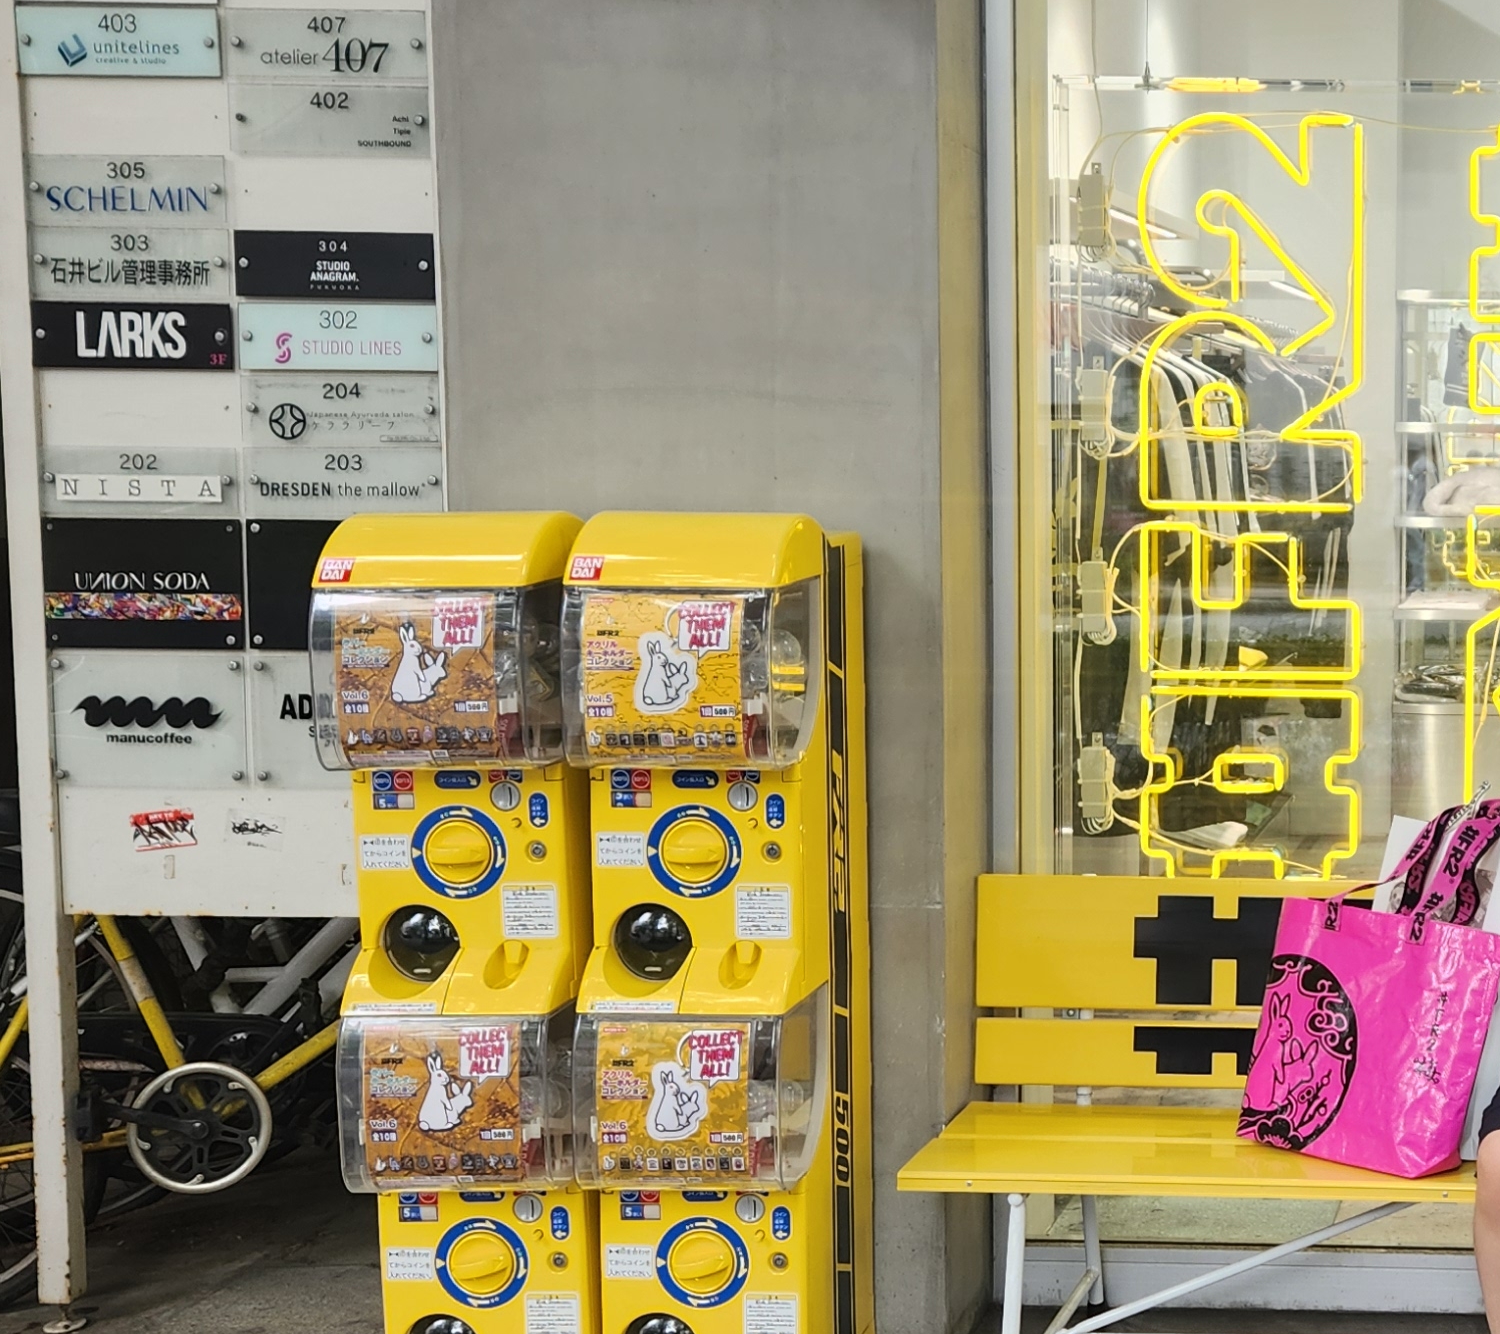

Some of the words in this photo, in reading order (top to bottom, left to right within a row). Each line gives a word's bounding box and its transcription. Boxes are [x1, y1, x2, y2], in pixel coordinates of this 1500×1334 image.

[98, 14, 137, 33] 403
[307, 16, 346, 34] 407
[94, 40, 180, 55] unitelines
[260, 48, 319, 65] atelier
[322, 37, 389, 73] 407
[310, 92, 349, 109] 402
[107, 162, 145, 179] 305
[46, 185, 208, 212] SCHELMIN
[110, 234, 149, 251] 303
[318, 241, 348, 252] 304
[50, 257, 210, 286] 石井ビル管理事務所
[316, 260, 350, 271] STUDIO
[310, 272, 360, 282] ANAGRAM.
[319, 310, 357, 329] 302
[76, 310, 187, 359] LARKS
[302, 340, 354, 355] STUDIO
[360, 340, 402, 355] LINES
[210, 354, 228, 365] 3F
[322, 382, 361, 399] 204
[119, 453, 158, 470] 202
[324, 454, 362, 471] 203
[260, 482, 331, 496] DRESDEN
[338, 482, 362, 496] the
[571, 568, 594, 578] DAI
[153, 572, 210, 590] SODA
[440, 613, 478, 631] THEM
[686, 617, 725, 632] THEM
[343, 656, 389, 664] コレクション
[587, 658, 633, 666] コレクション
[343, 691, 369, 700] Vol.6
[587, 694, 613, 703] Vol.5
[106, 732, 193, 744] manucoffee
[458, 1027, 513, 1045] COLLECT
[688, 1030, 745, 1049] COLLECT
[467, 1044, 505, 1059] THEM
[697, 1048, 735, 1064] THEM
[371, 1085, 417, 1093] コレクション
[602, 1087, 648, 1095] コレクション
[371, 1119, 397, 1128] Vol.6
[602, 1121, 627, 1130] Vol.6
[834, 1097, 851, 1182] 500
